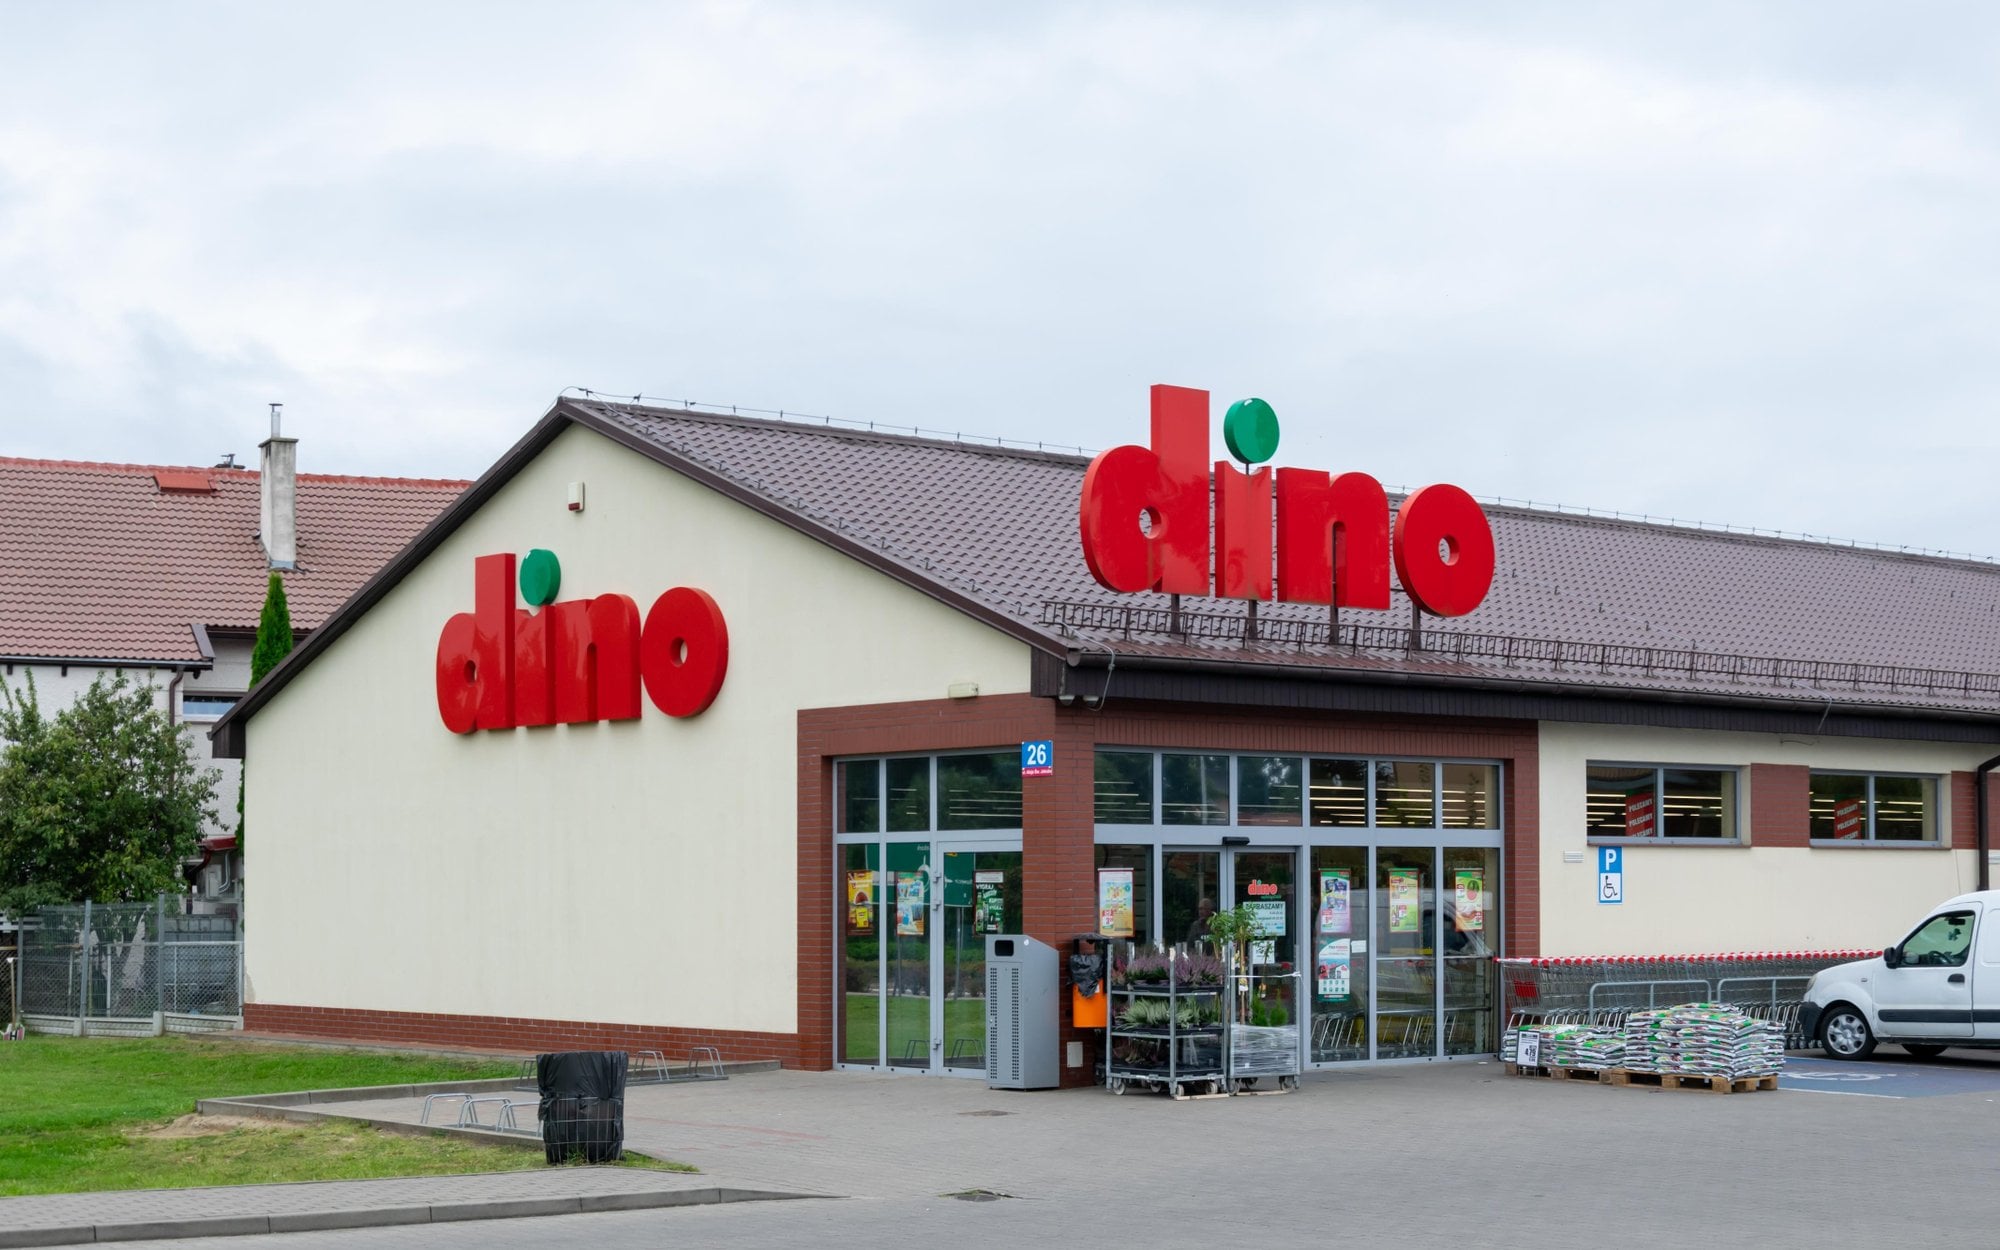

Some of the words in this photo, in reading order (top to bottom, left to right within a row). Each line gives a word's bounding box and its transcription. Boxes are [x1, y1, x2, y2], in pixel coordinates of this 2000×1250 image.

[1080, 383, 1495, 618] dino
[436, 548, 729, 734] dino
[1027, 744, 1047, 765] 26
[1628, 799, 1653, 812] POLECAMY
[1628, 813, 1653, 827] POLECAMY
[1605, 849, 1617, 871] P
[1248, 879, 1278, 895] dino
